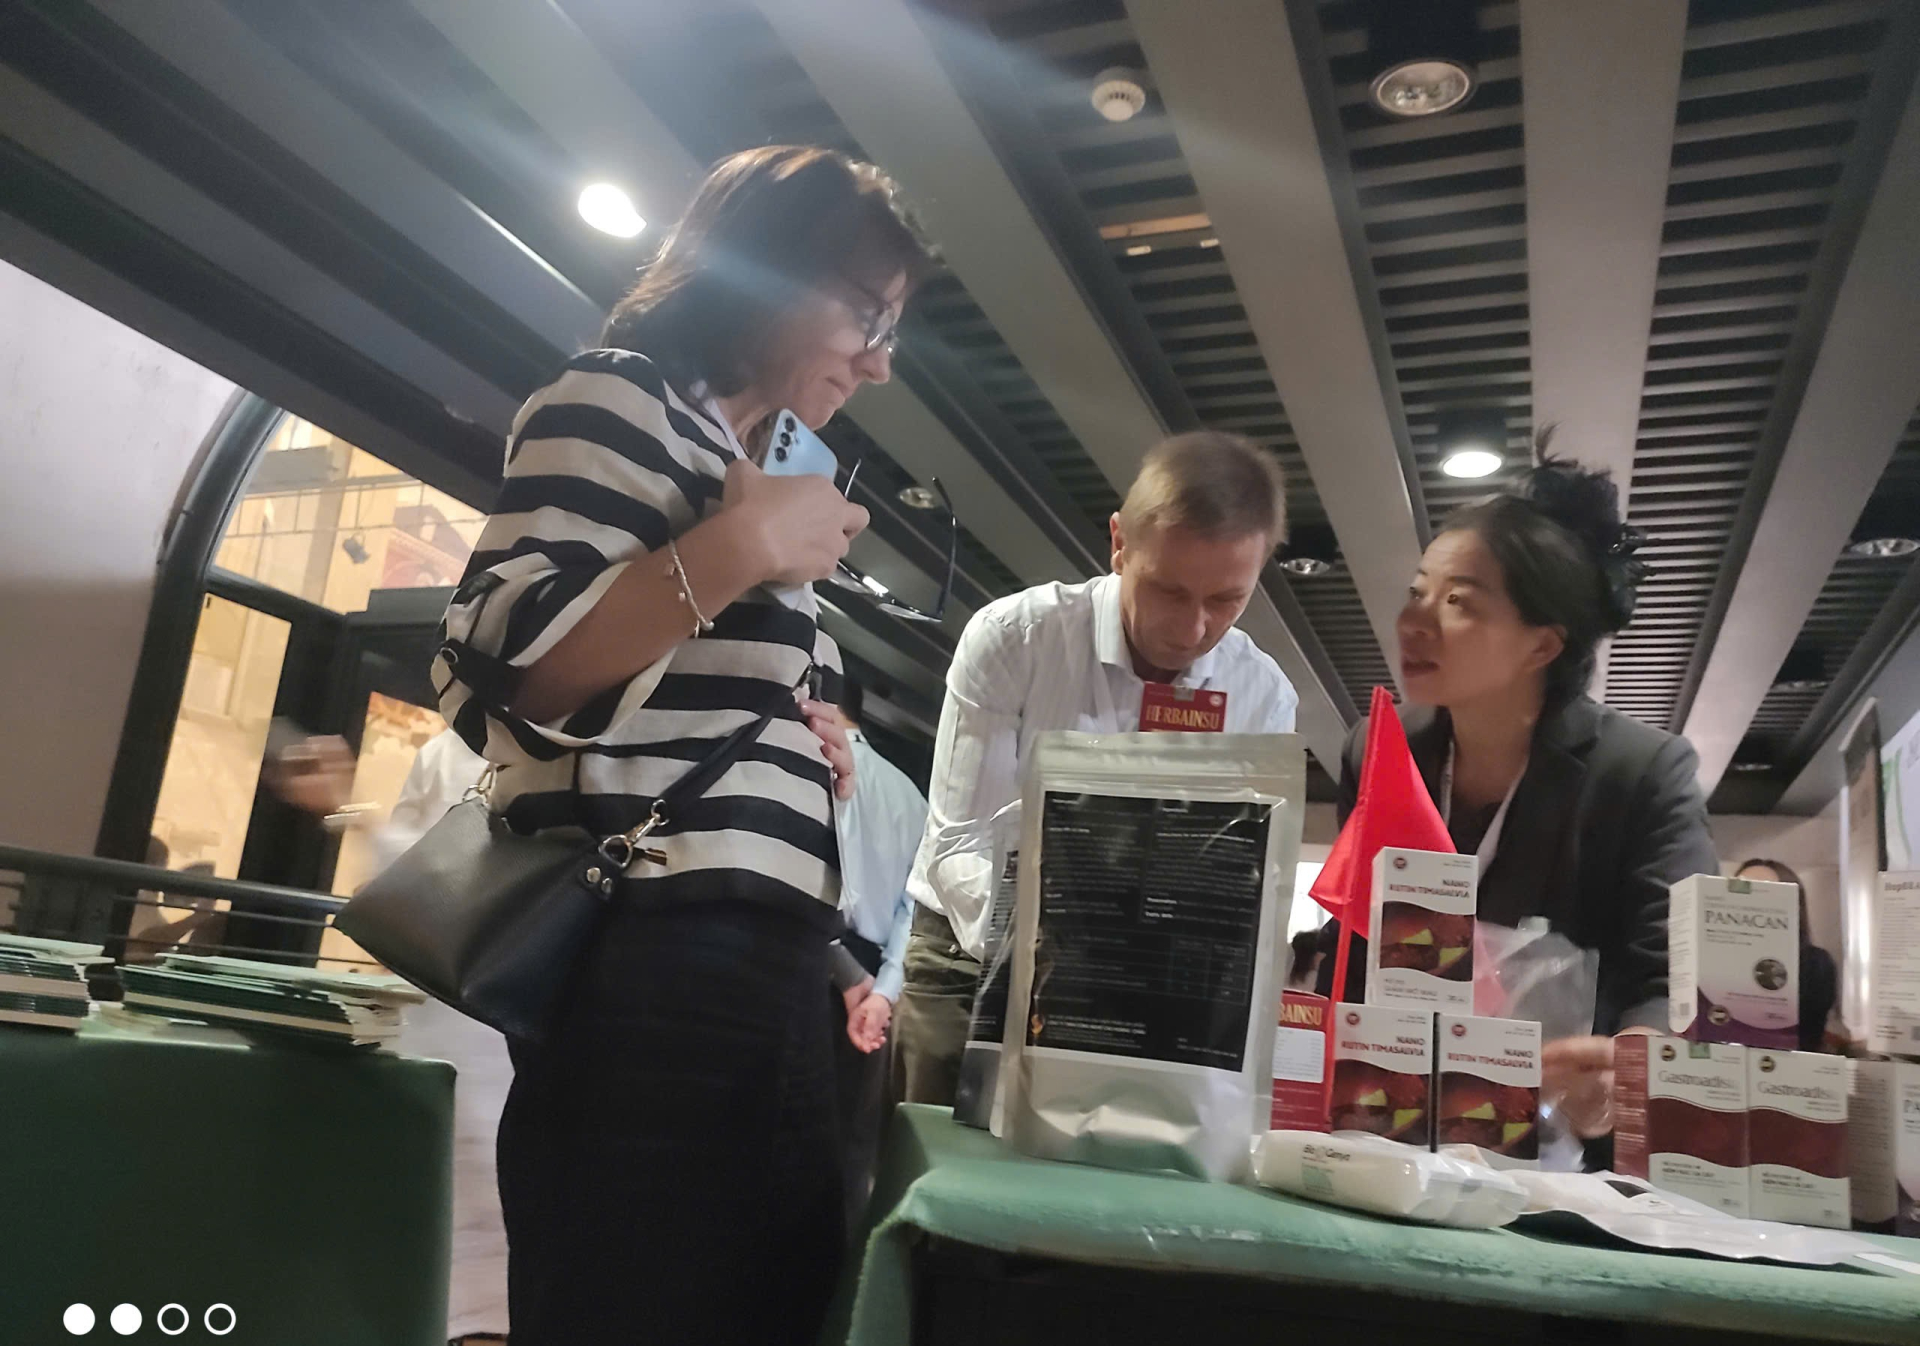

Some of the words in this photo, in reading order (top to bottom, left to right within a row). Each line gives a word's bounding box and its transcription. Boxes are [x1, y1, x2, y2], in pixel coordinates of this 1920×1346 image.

[1145, 704, 1221, 730] HERBAINSU
[1442, 878, 1471, 889] NANO
[1704, 909, 1789, 931] PANACAN
[1396, 1036, 1426, 1047] NANO
[1504, 1047, 1534, 1059] NANO
